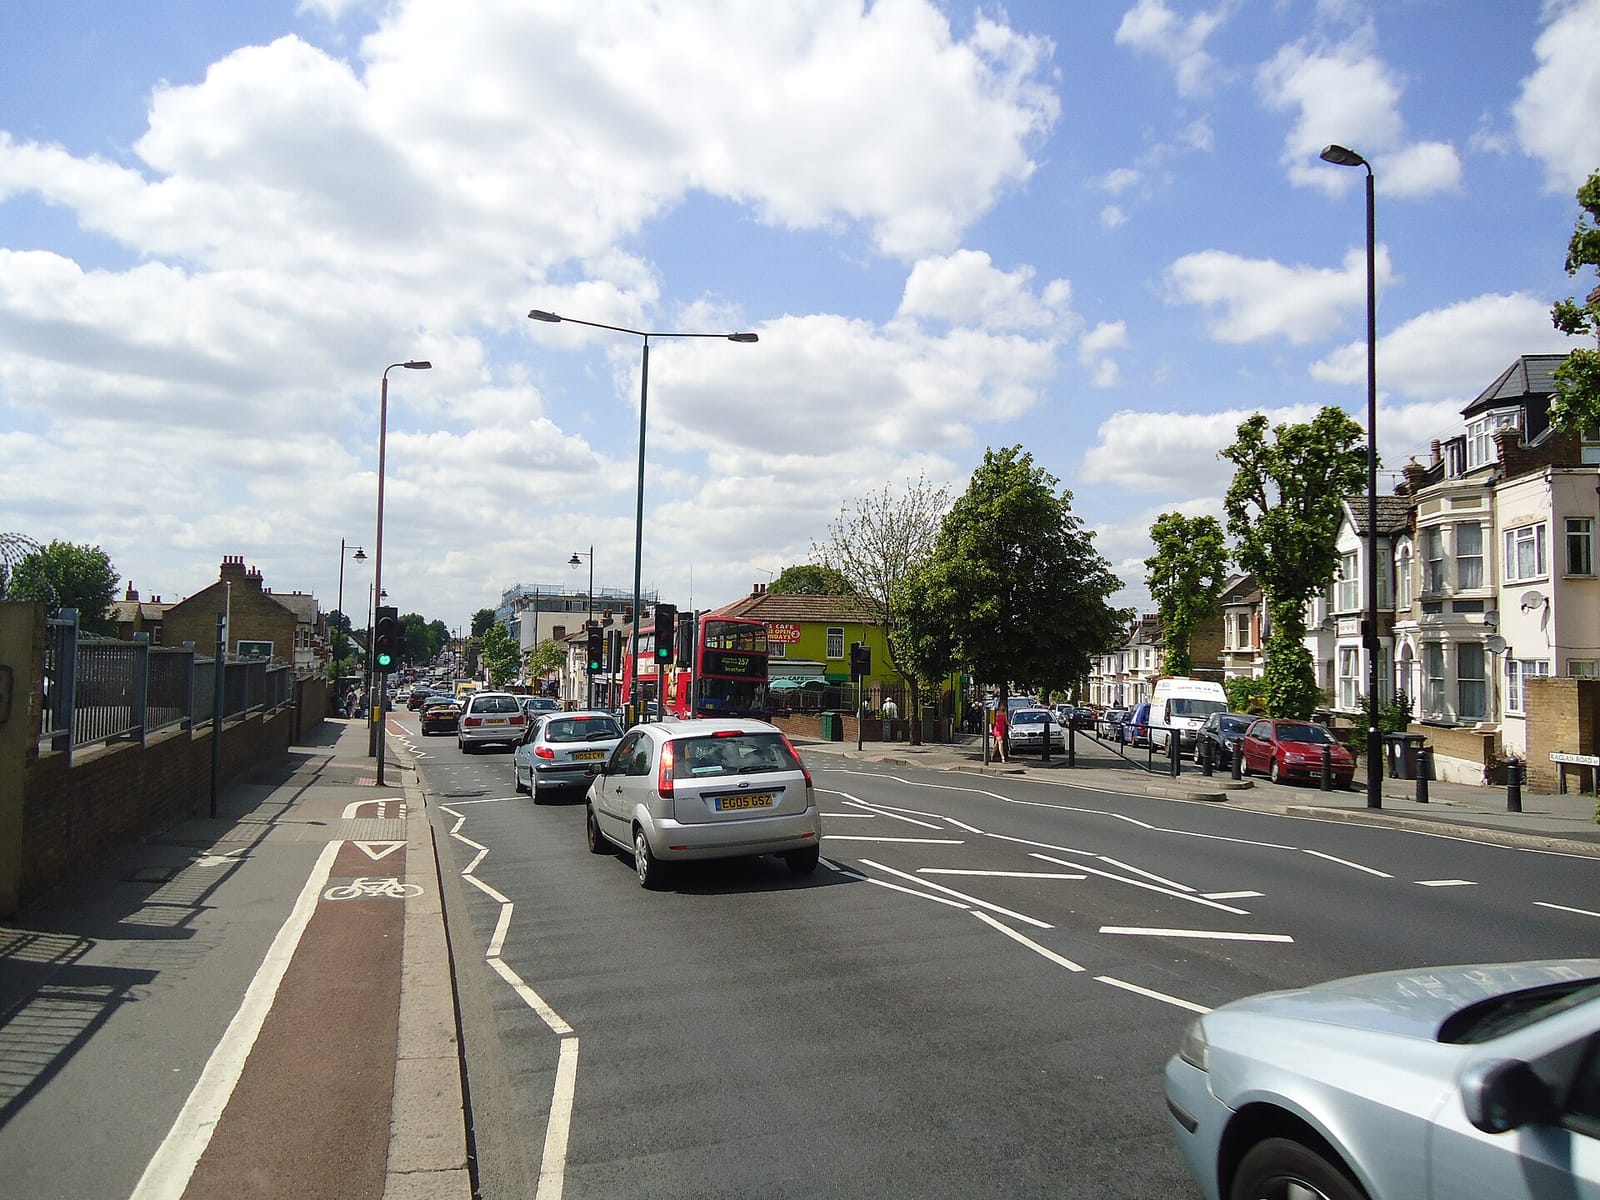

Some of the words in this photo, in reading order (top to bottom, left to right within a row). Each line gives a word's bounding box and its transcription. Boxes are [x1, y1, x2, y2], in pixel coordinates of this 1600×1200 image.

[737, 657, 750, 666] 257
[1575, 756, 1593, 764] ROAD
[722, 797, 749, 809] EG05
[751, 795, 771, 806] GSZ
